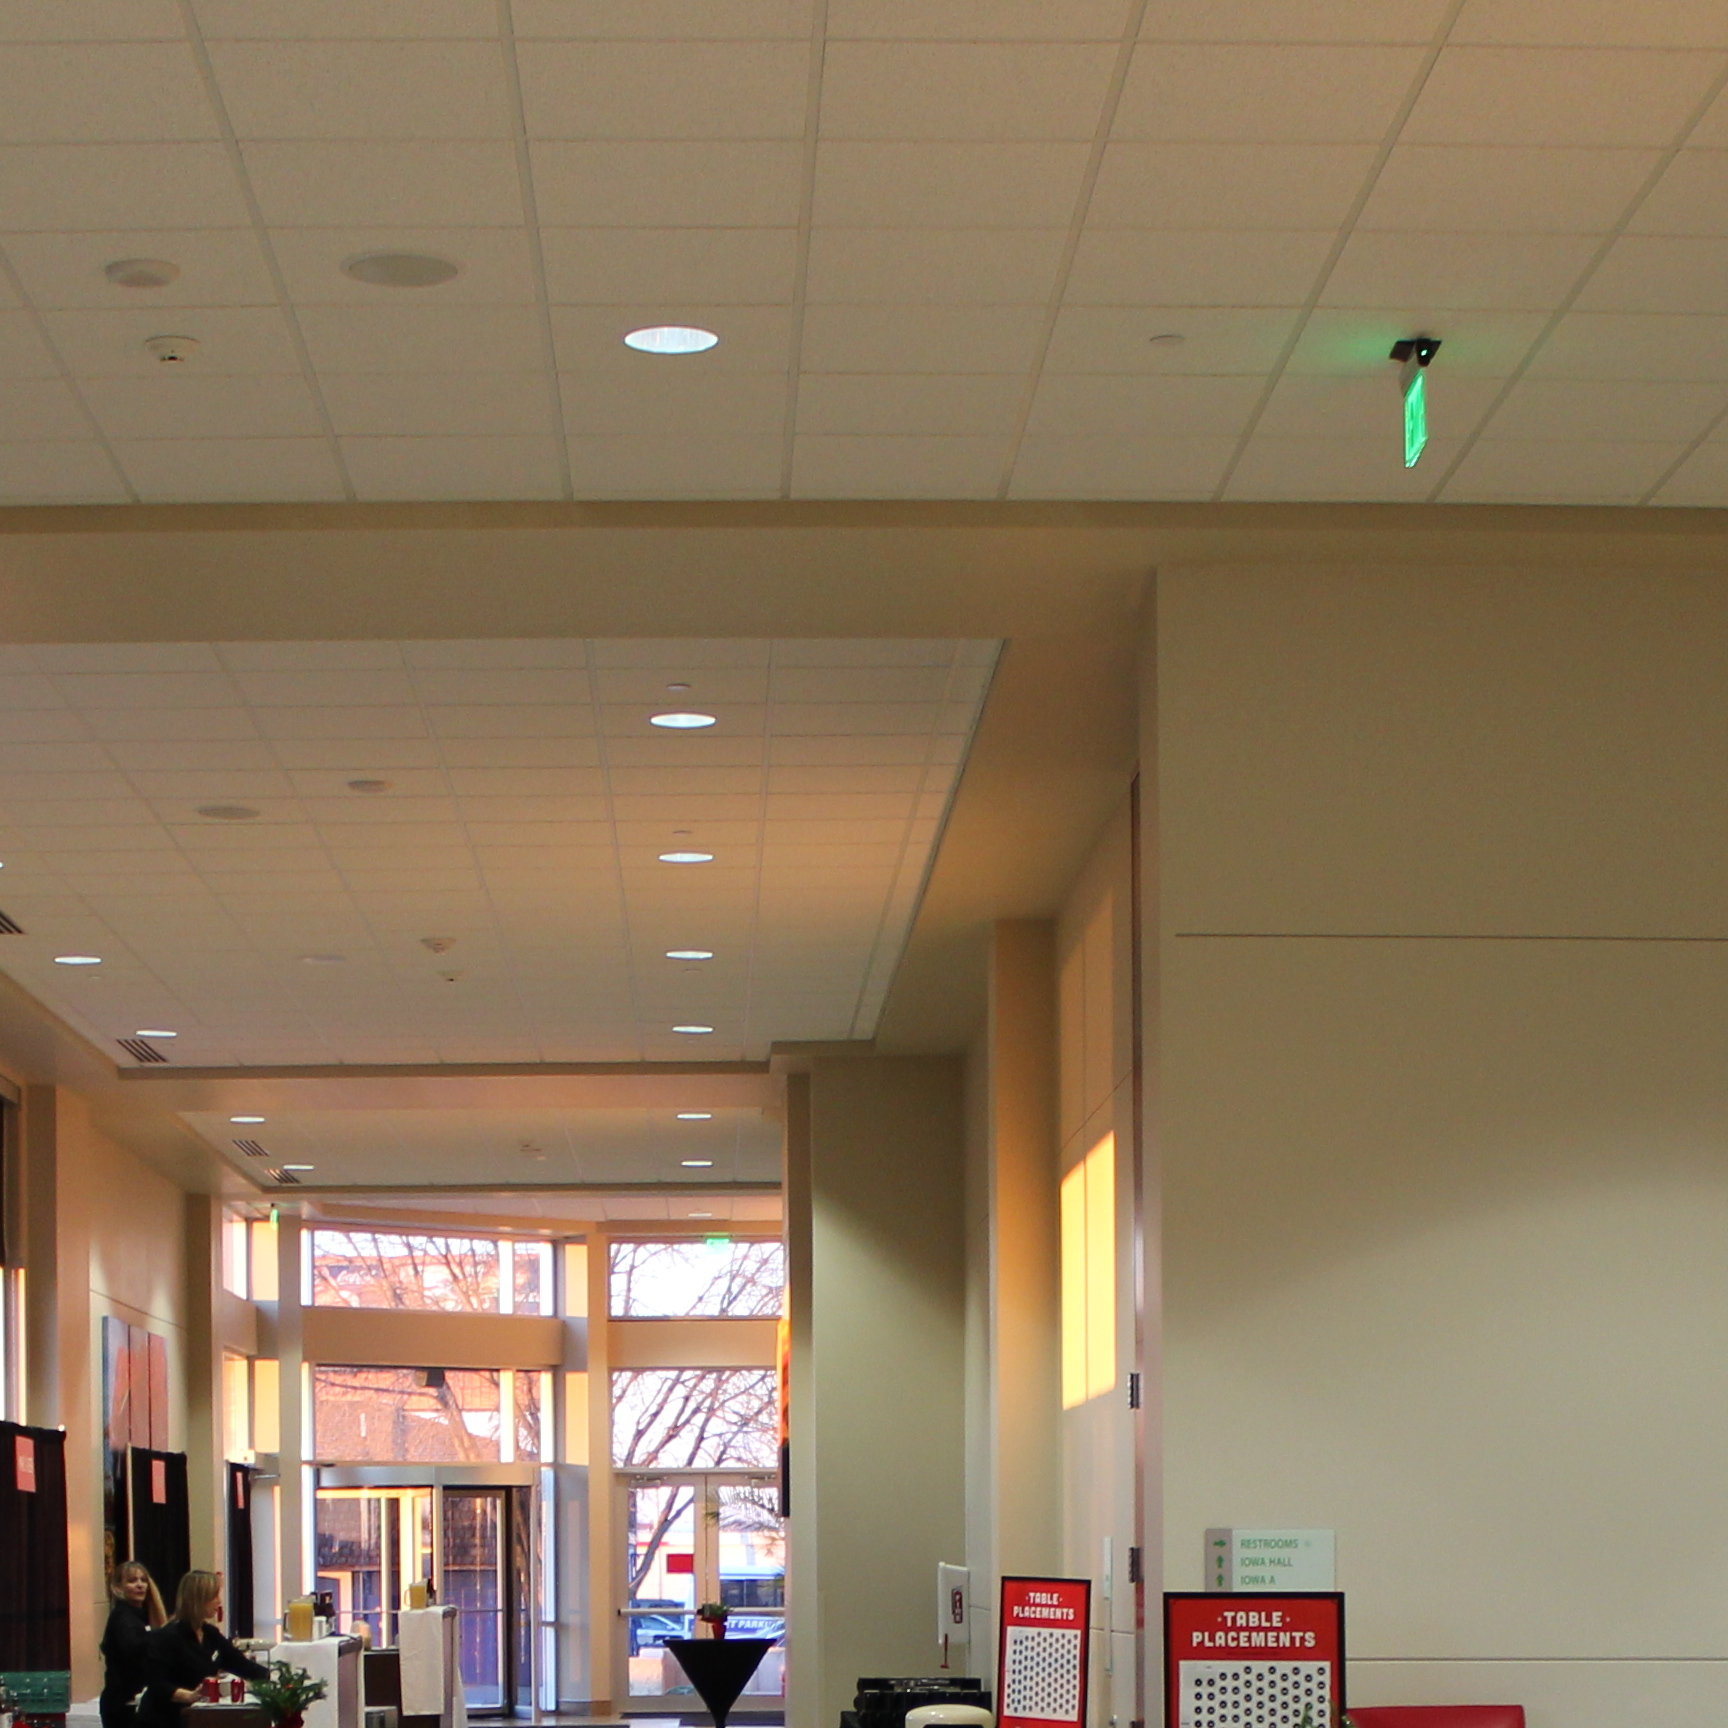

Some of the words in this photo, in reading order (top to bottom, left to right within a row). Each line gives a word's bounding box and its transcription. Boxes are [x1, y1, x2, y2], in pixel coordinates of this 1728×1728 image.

[1240, 1539, 1299, 1549] RESTROOMS
[1240, 1557, 1266, 1568] IOWA
[1269, 1557, 1293, 1568] HALL
[1240, 1575, 1266, 1586] IOWA
[1269, 1575, 1276, 1585] A
[1029, 1592, 1059, 1605] TABLE
[1013, 1606, 1075, 1620] PLACEMENTS
[1223, 1611, 1282, 1627] TABLE
[1192, 1631, 1316, 1648] PLACEMENTS
